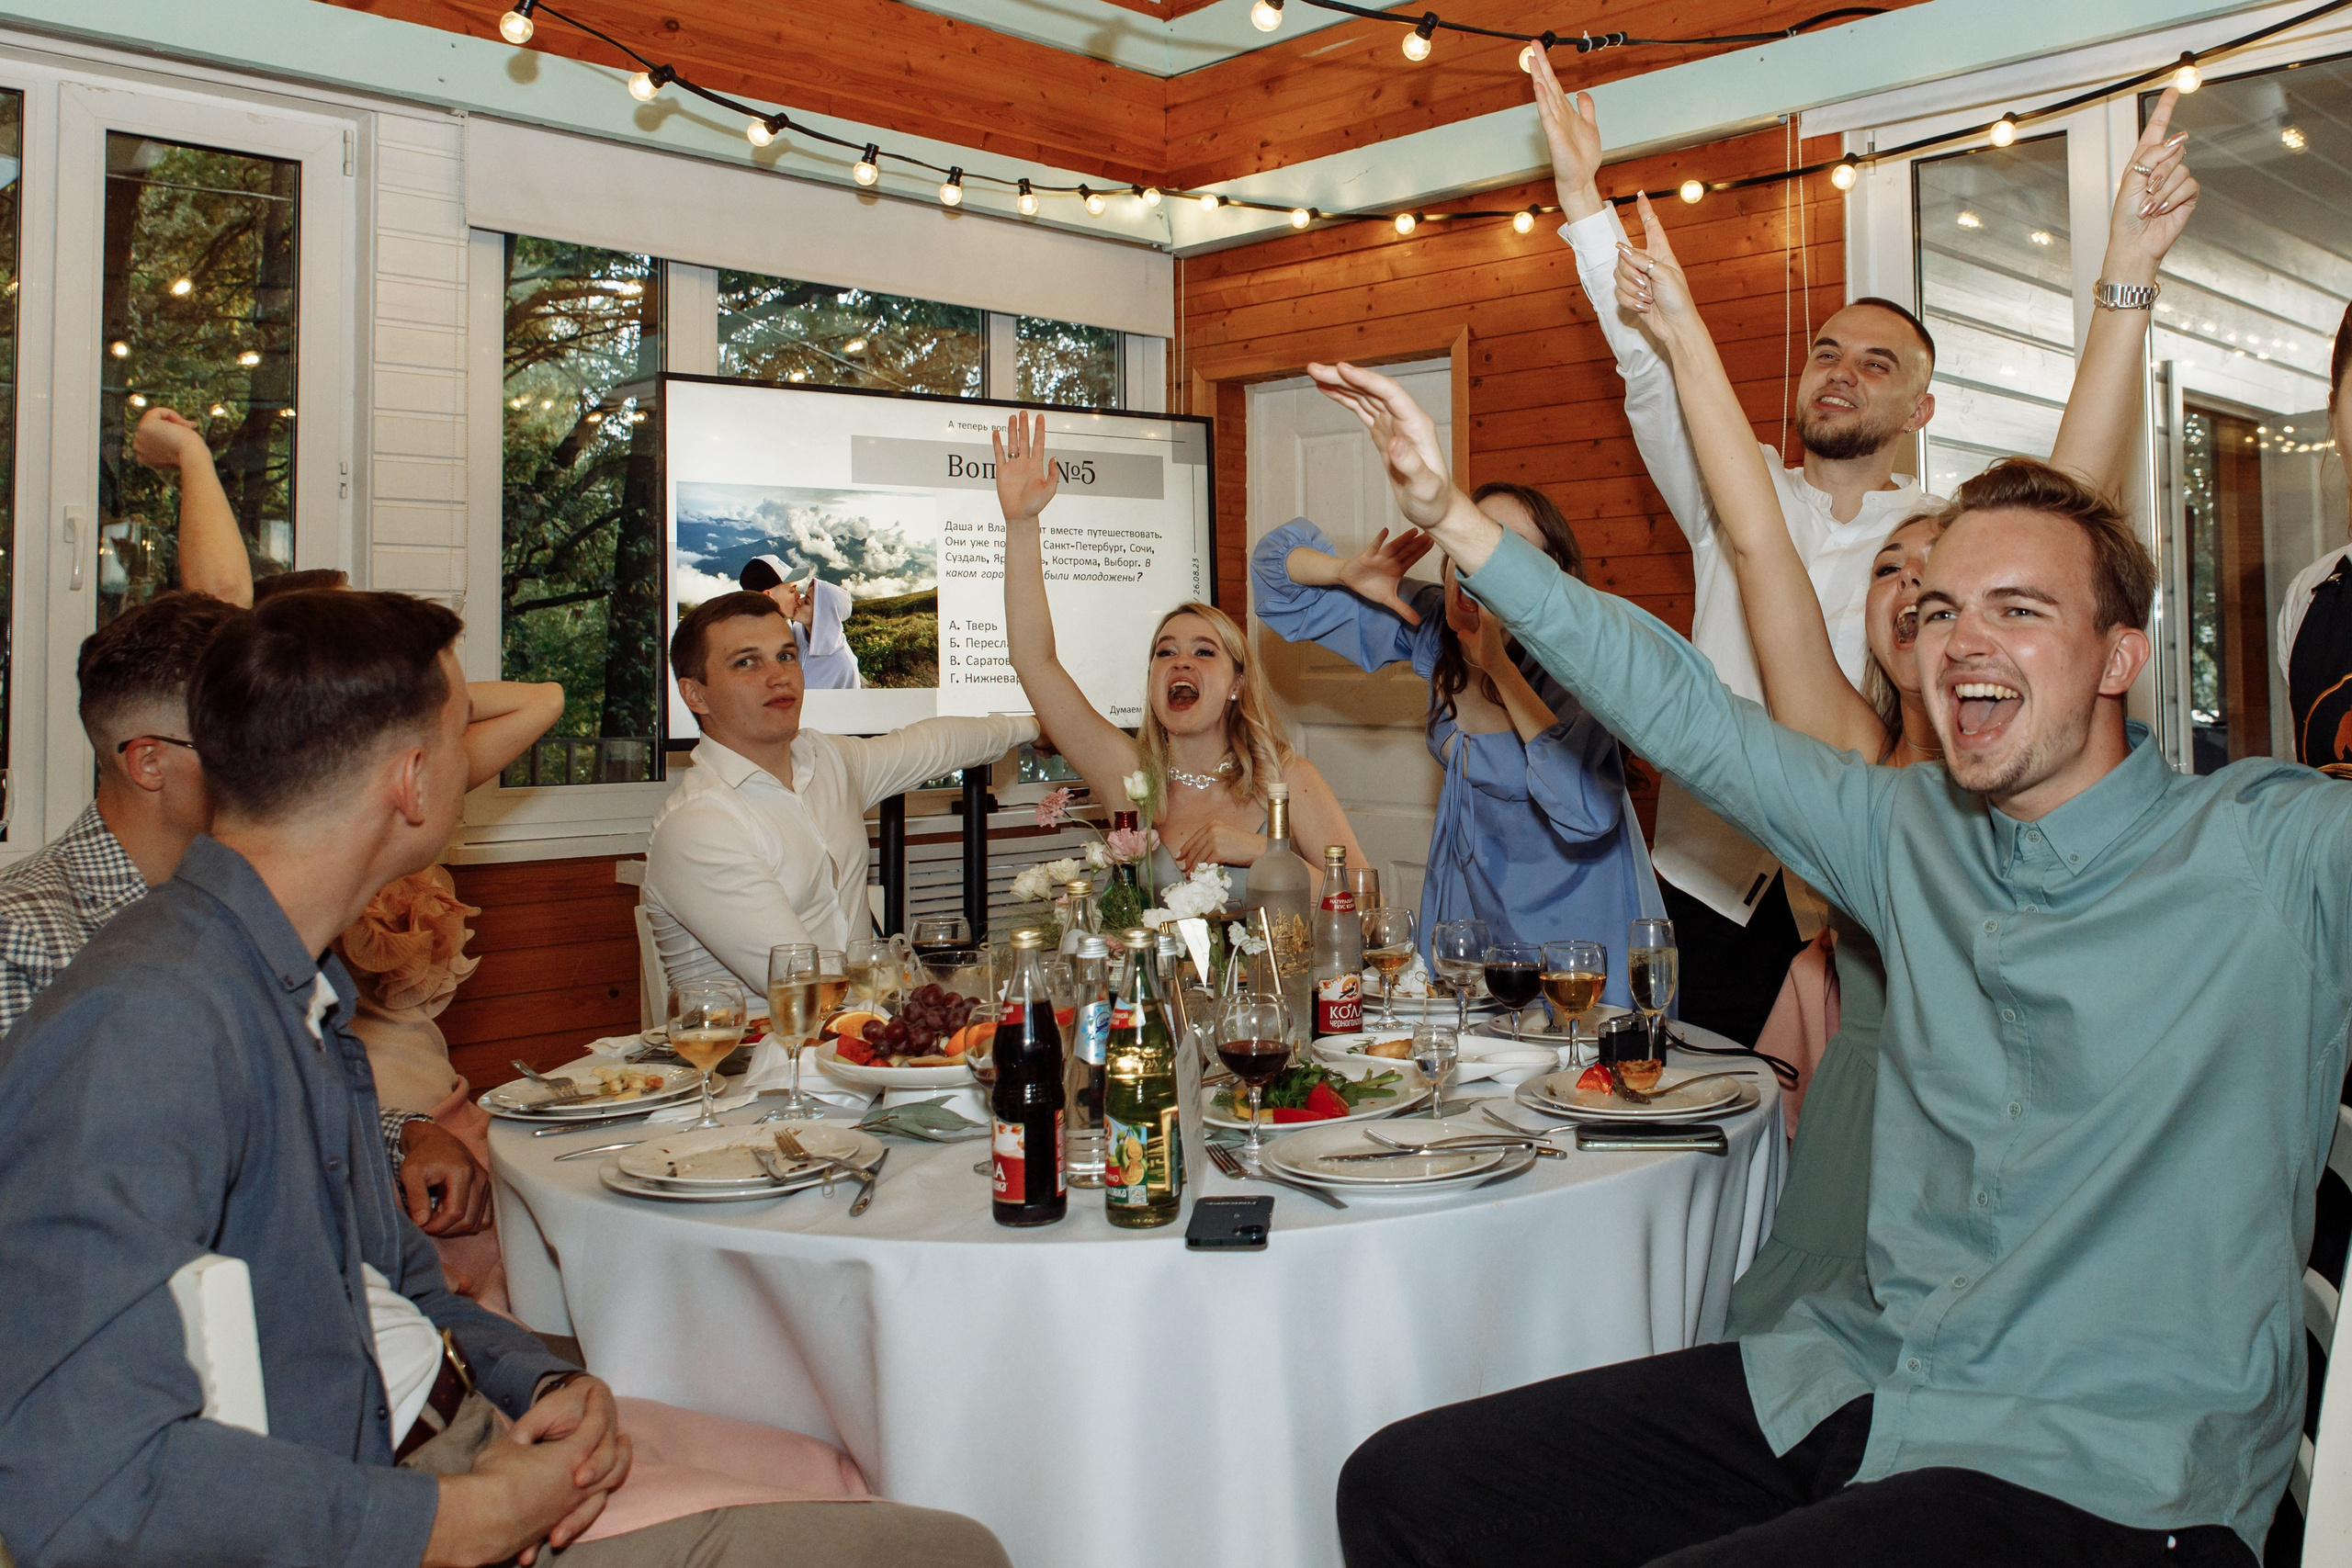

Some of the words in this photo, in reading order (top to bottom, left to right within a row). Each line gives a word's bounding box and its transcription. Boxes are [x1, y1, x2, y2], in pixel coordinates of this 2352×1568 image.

[947, 420, 955, 429] А
[957, 422, 989, 432] теперь
[947, 454, 996, 479] Воп
[1056, 459, 1096, 485] №5
[944, 521, 973, 532] Даша
[988, 522, 1006, 533] Вла
[1050, 527, 1084, 536] вместе
[1087, 528, 1162, 539] путешествовать.
[944, 536, 967, 547] Они
[970, 539, 989, 548] уже
[1043, 539, 1126, 554] Санкт-Петербург,
[1129, 543, 1155, 555] Сочи,
[945, 552, 989, 564] Суздаль,
[1052, 555, 1101, 567] Кострома,
[1103, 557, 1141, 569] Выборг.
[1145, 558, 1151, 568] В
[945, 570, 978, 578] каком
[981, 571, 1005, 581] горо
[1044, 570, 1069, 581] были
[1072, 571, 1144, 582] молодожены?
[1192, 558, 1201, 595] 26.08.23
[948, 620, 960, 631] А.
[966, 620, 998, 633] Тверь
[950, 637, 960, 649] Б.
[966, 637, 1009, 650] Пересл
[950, 655, 961, 666] В.
[966, 655, 1011, 668] Саратов
[950, 673, 959, 683] Г.
[965, 673, 1021, 685] Нижневар
[1109, 705, 1143, 716] Думаем
